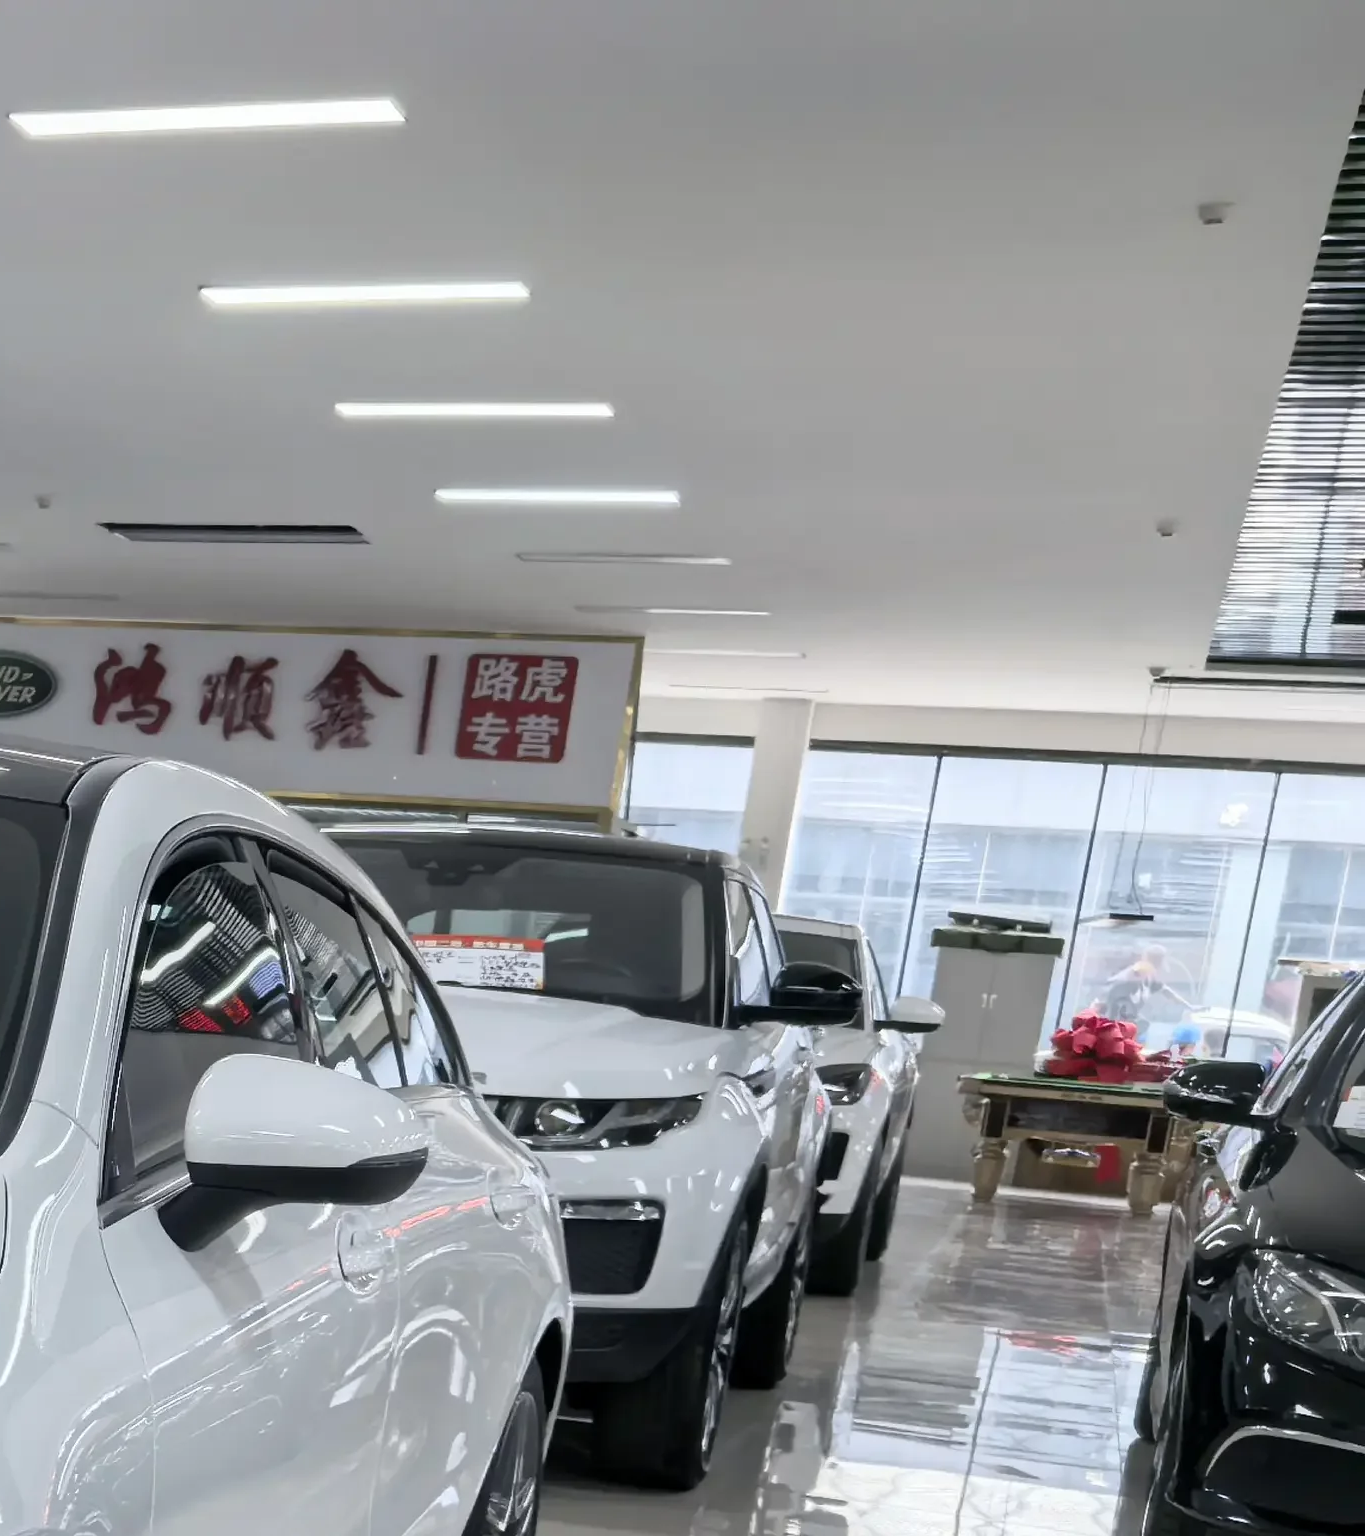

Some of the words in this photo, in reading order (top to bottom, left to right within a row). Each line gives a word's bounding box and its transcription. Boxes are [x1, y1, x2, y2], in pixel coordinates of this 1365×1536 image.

[92, 643, 404, 751] 鸿顺鑫
[471, 658, 568, 703] 路虎
[466, 711, 560, 759] 专营
